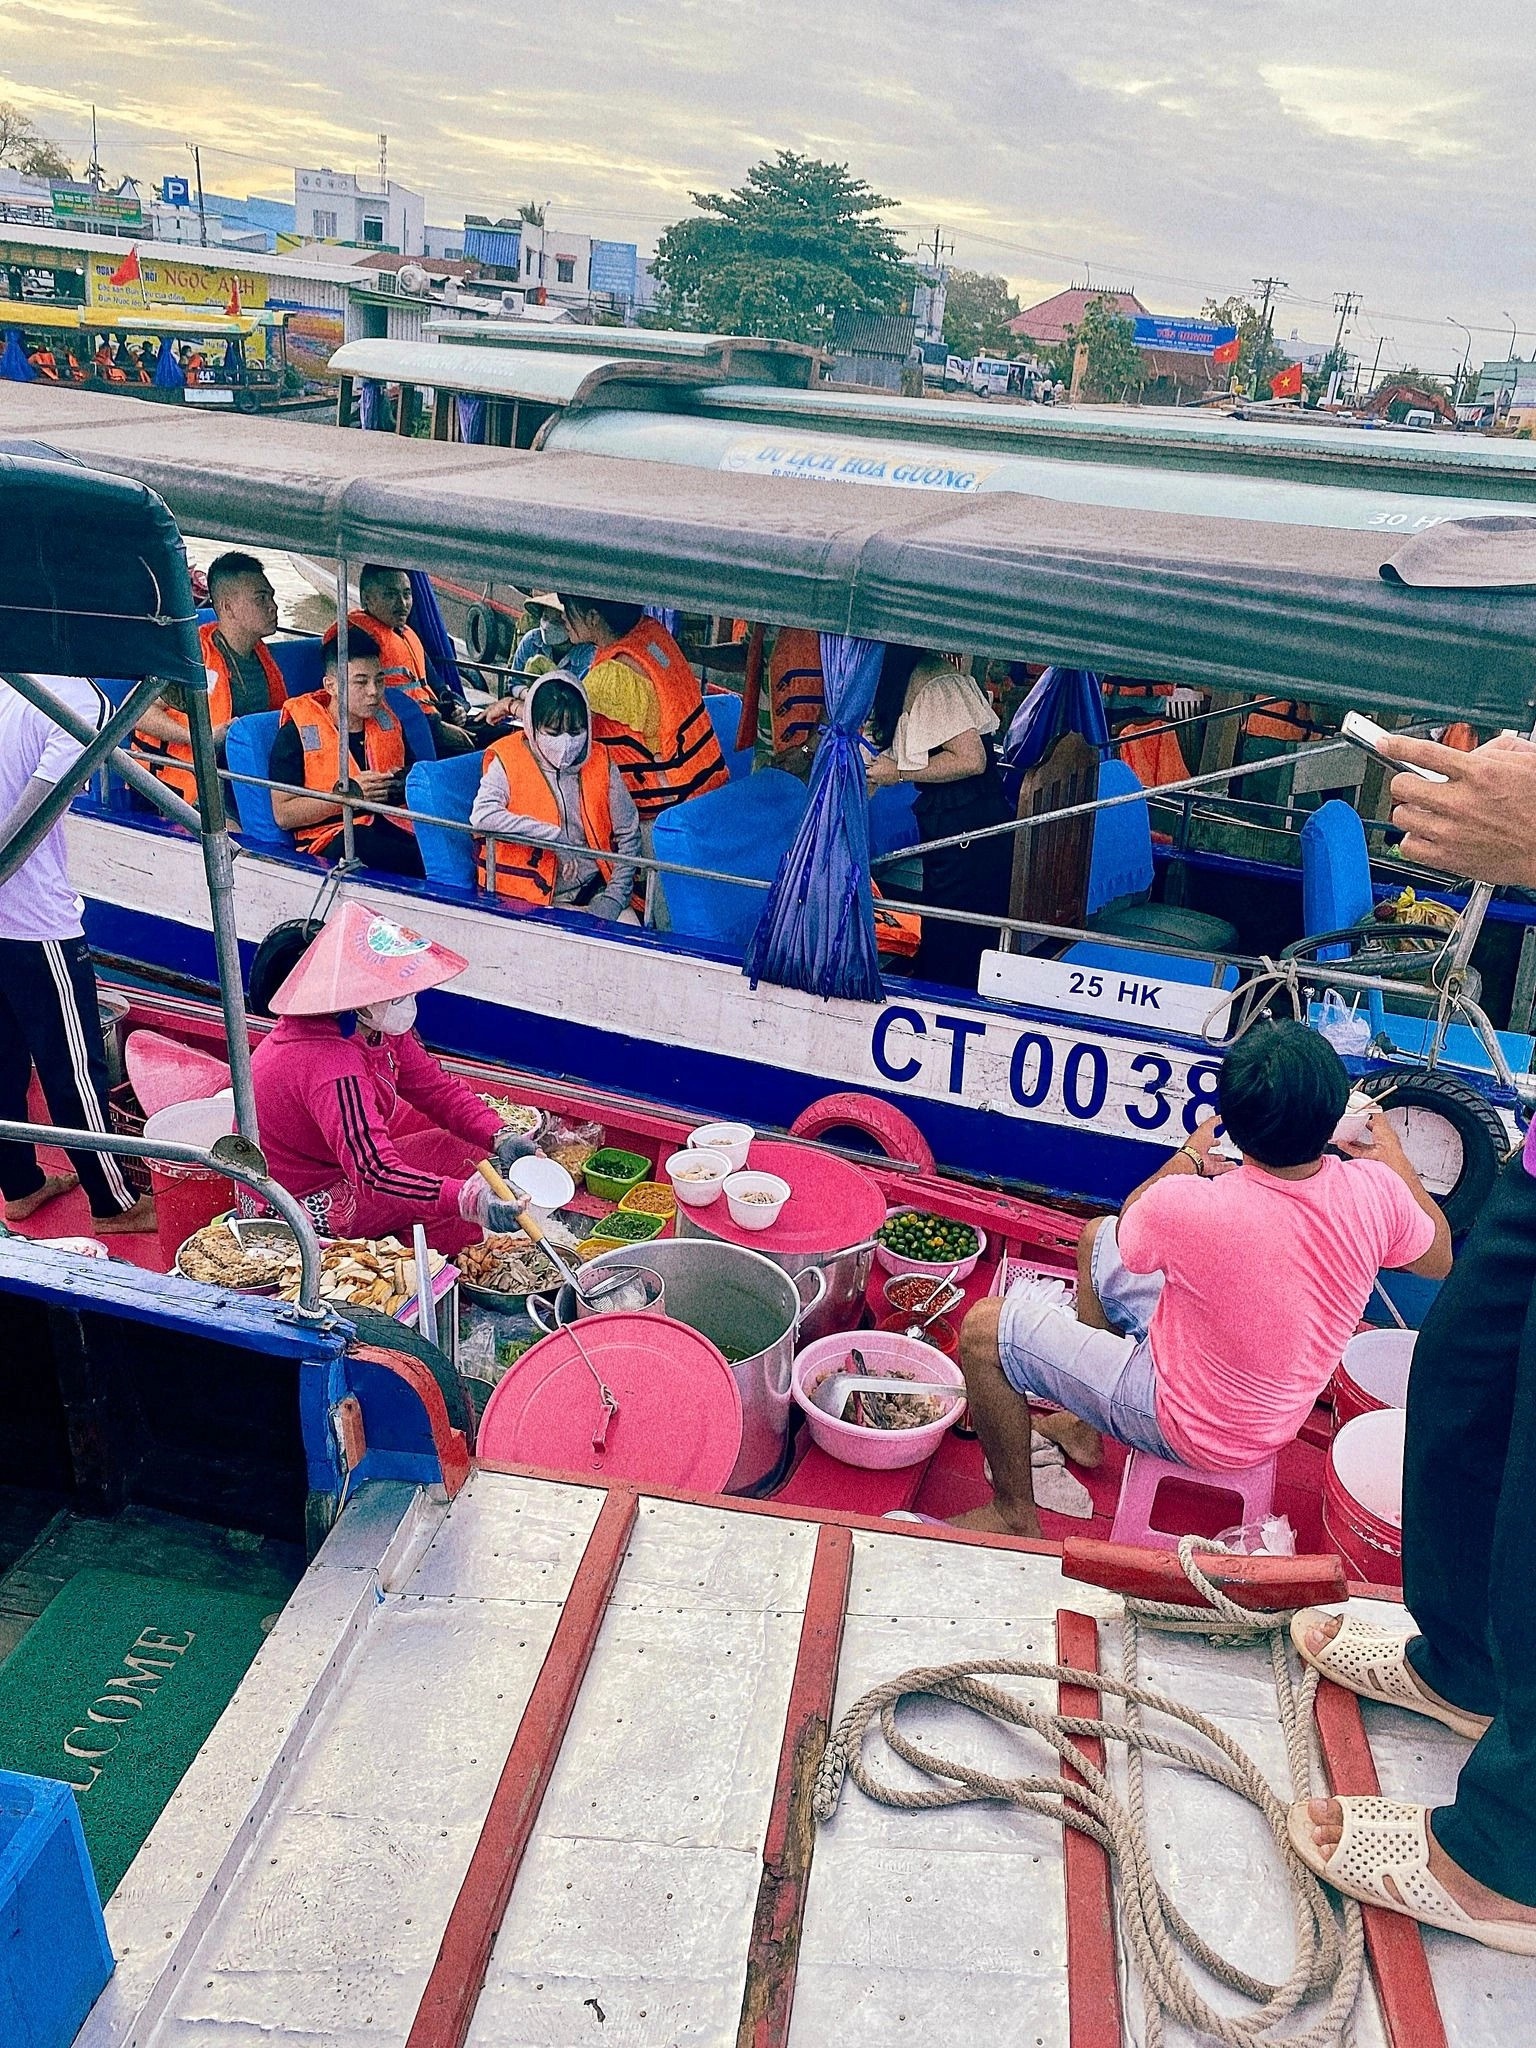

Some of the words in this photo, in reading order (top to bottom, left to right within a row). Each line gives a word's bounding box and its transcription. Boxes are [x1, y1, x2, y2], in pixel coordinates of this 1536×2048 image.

[168, 182, 185, 200] P
[1367, 512, 1408, 526] 30
[1068, 972, 1104, 998] 25
[1117, 980, 1164, 1010] HK
[871, 1005, 986, 1095] CT
